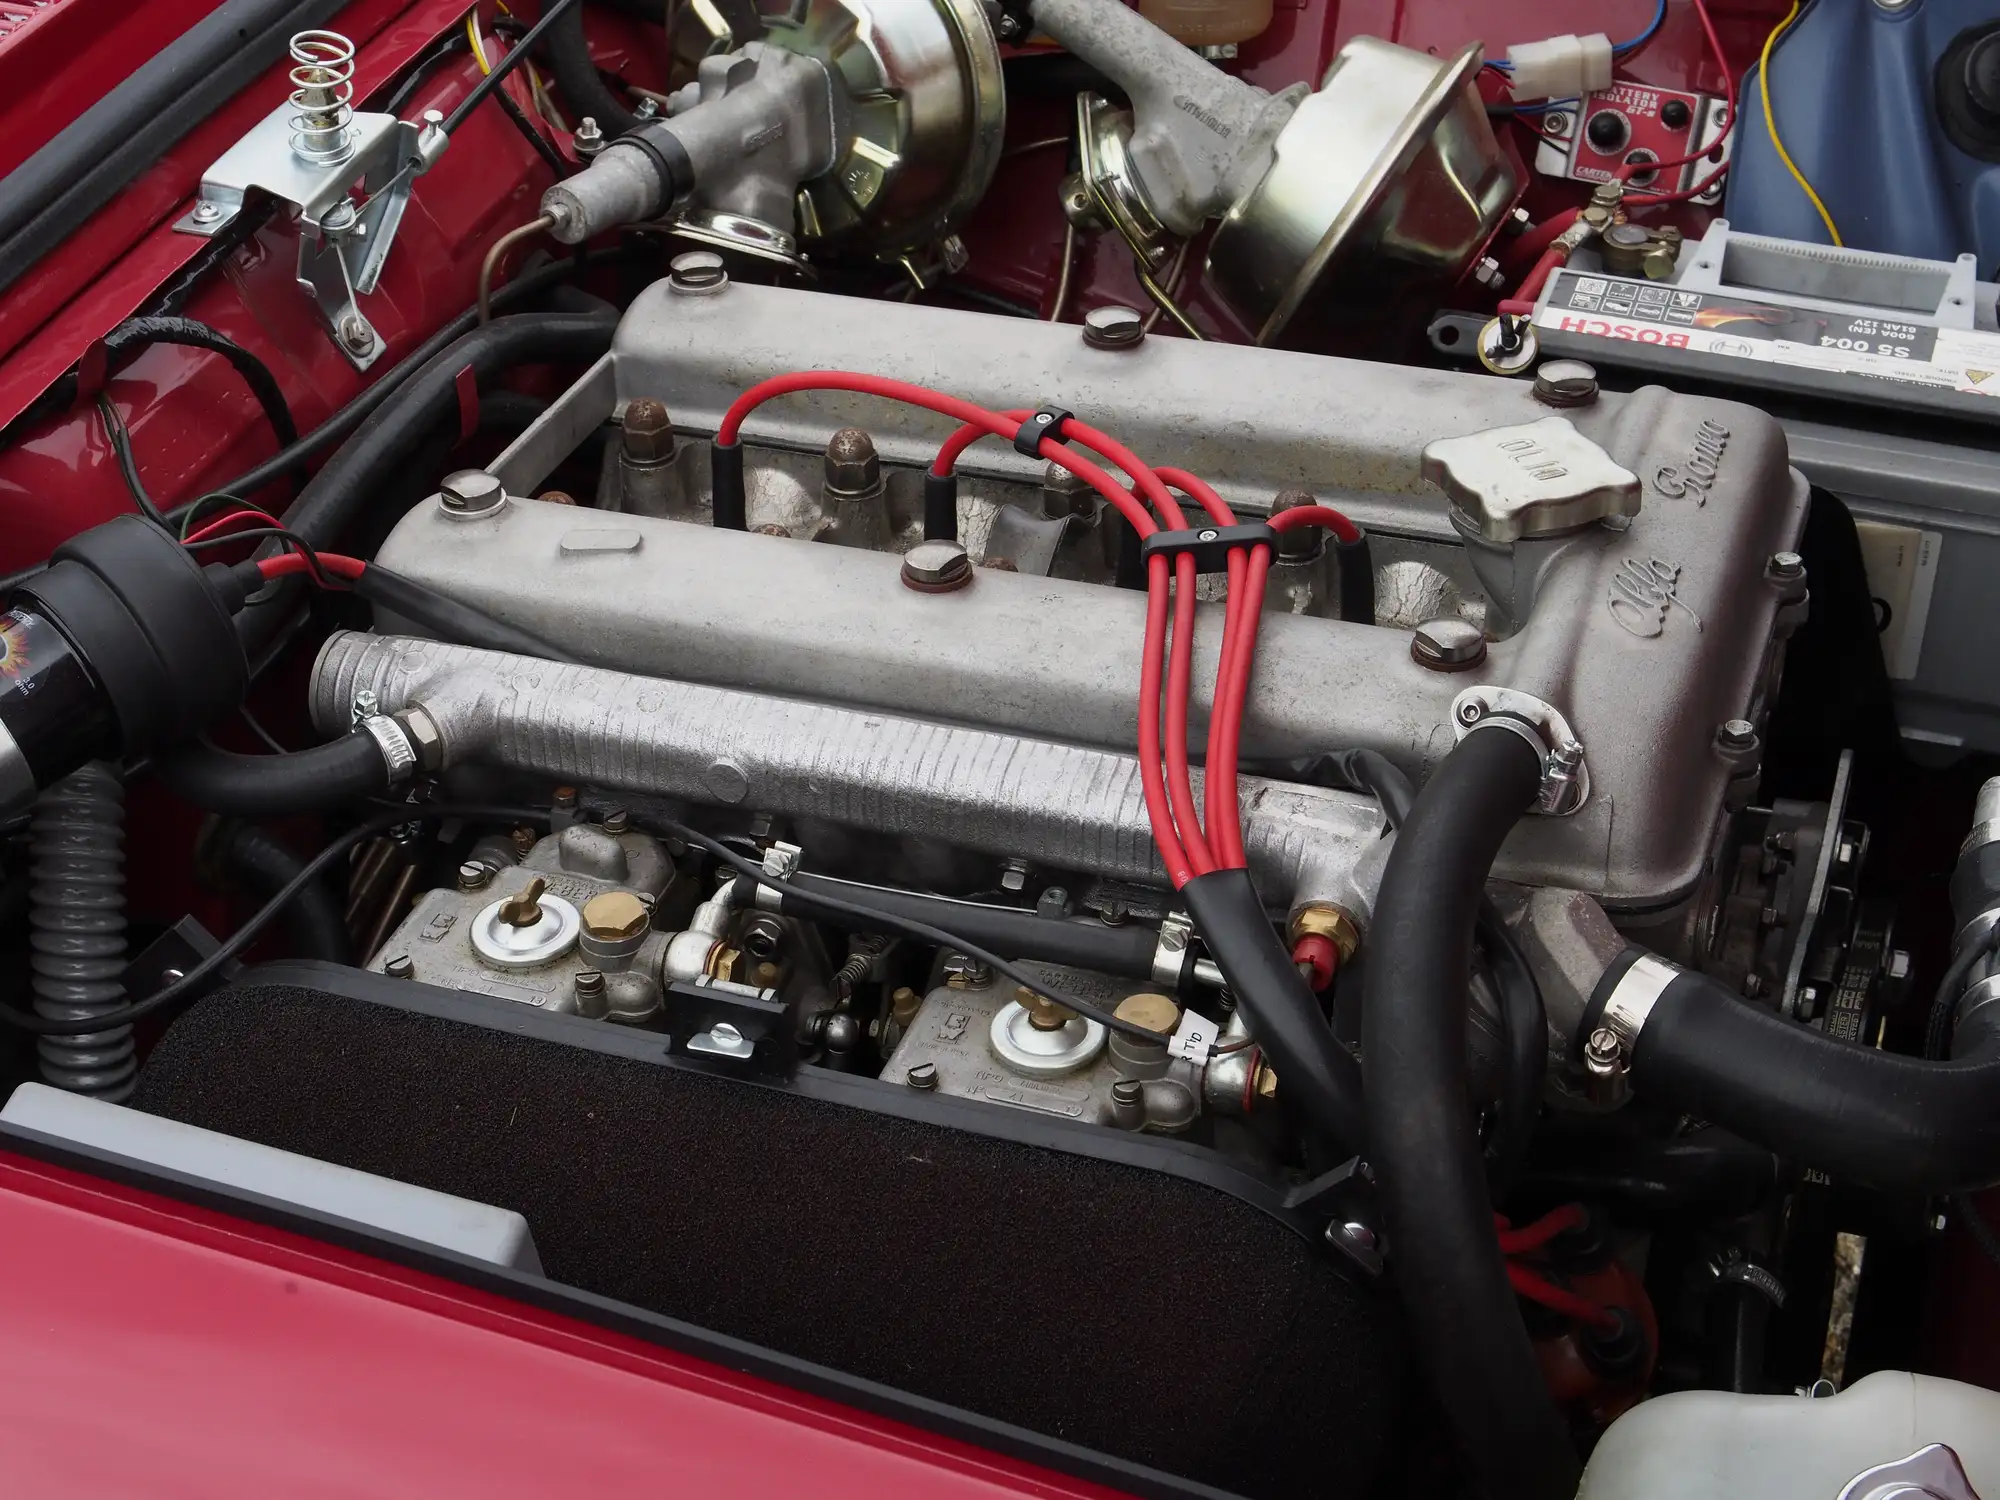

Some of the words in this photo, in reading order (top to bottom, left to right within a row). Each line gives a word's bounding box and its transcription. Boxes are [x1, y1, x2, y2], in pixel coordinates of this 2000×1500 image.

[1593, 92, 1658, 109] ISOLATOR
[1606, 85, 1660, 101] ATTERY
[1848, 325, 1876, 336] (EN)
[1854, 318, 1878, 328] 12V
[1559, 316, 1690, 350] BOSCH
[1881, 329, 1915, 341] 600A
[1820, 335, 1869, 352] 004
[1878, 344, 1911, 359] S5
[1652, 418, 1730, 507] Romeo
[1607, 553, 1704, 639] Alfa
[14, 679, 30, 696] ohm
[23, 676, 35, 690] 3.0
[543, 881, 599, 901] EBER
